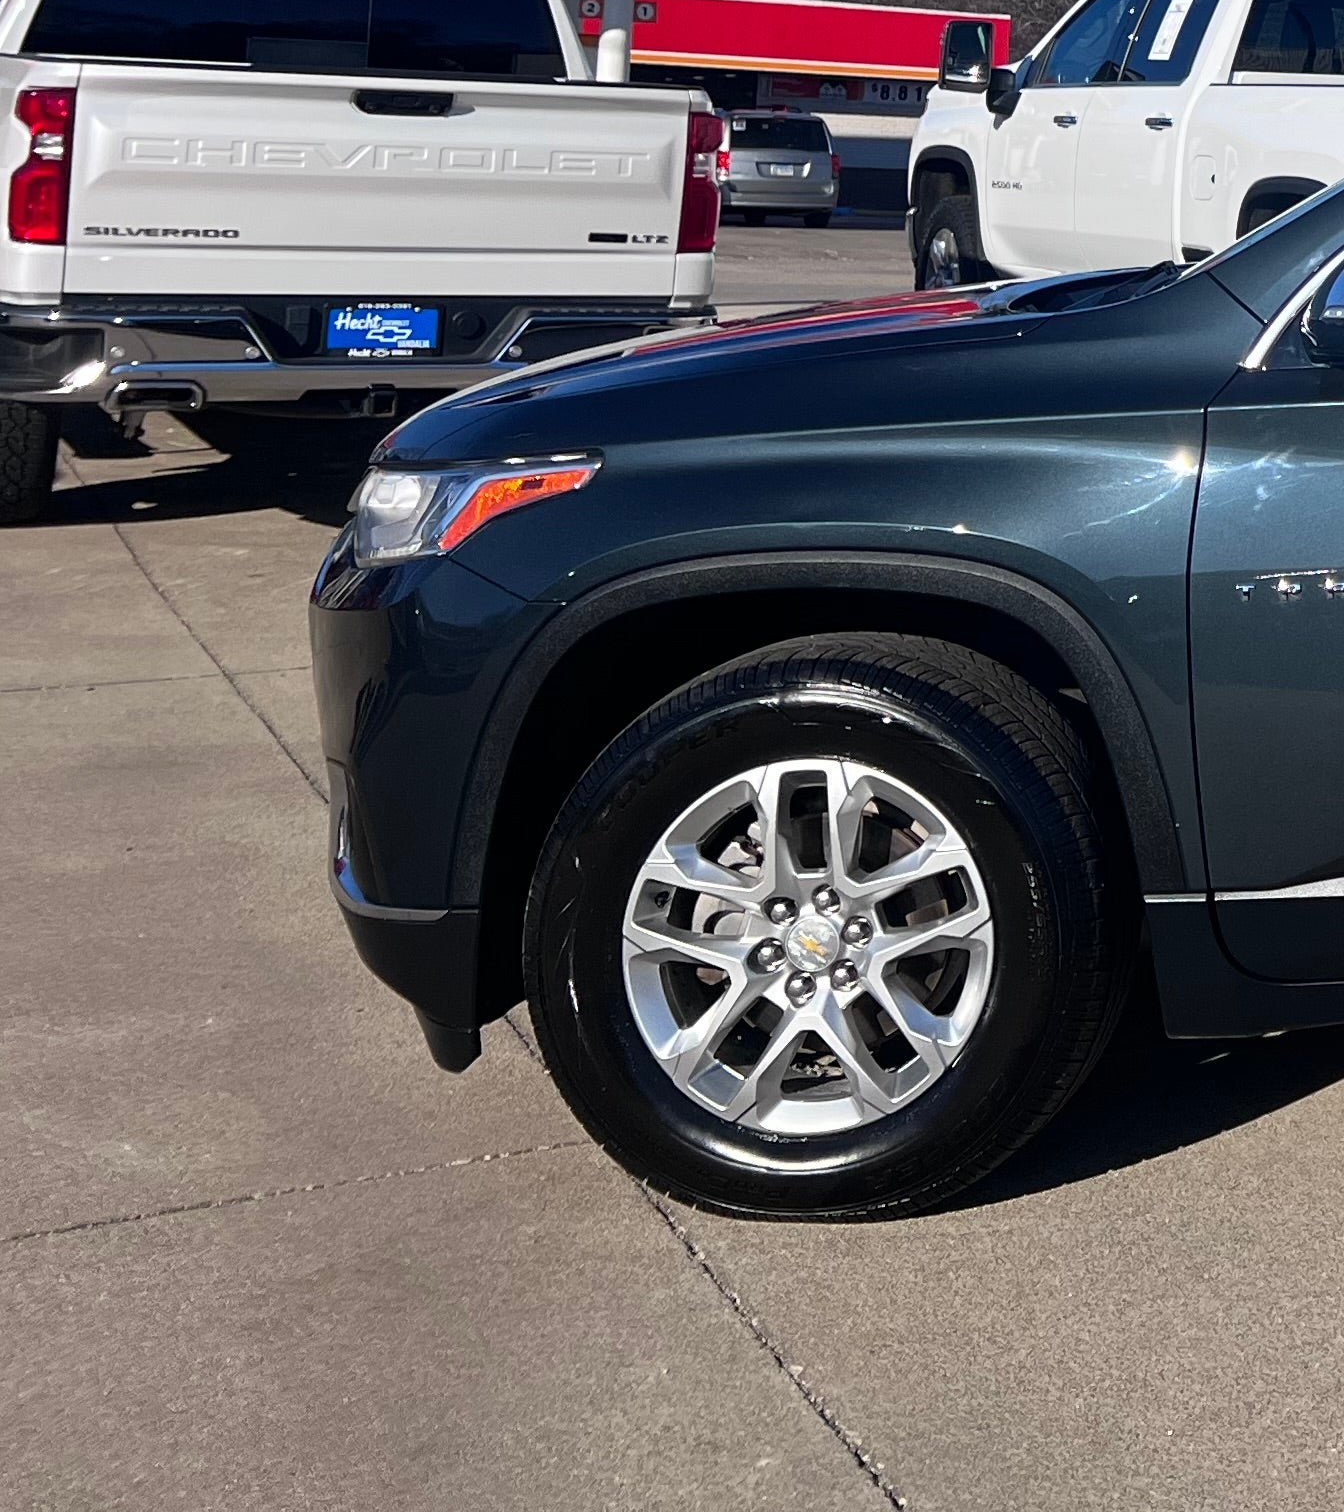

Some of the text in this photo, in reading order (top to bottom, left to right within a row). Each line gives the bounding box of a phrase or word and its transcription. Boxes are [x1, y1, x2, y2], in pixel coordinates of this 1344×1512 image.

[586, 2, 596, 14] 2
[121, 137, 651, 177] CHEVROLET
[83, 226, 240, 239] SILVERADO
[631, 234, 669, 244] LTZ
[334, 312, 383, 330] Hecht
